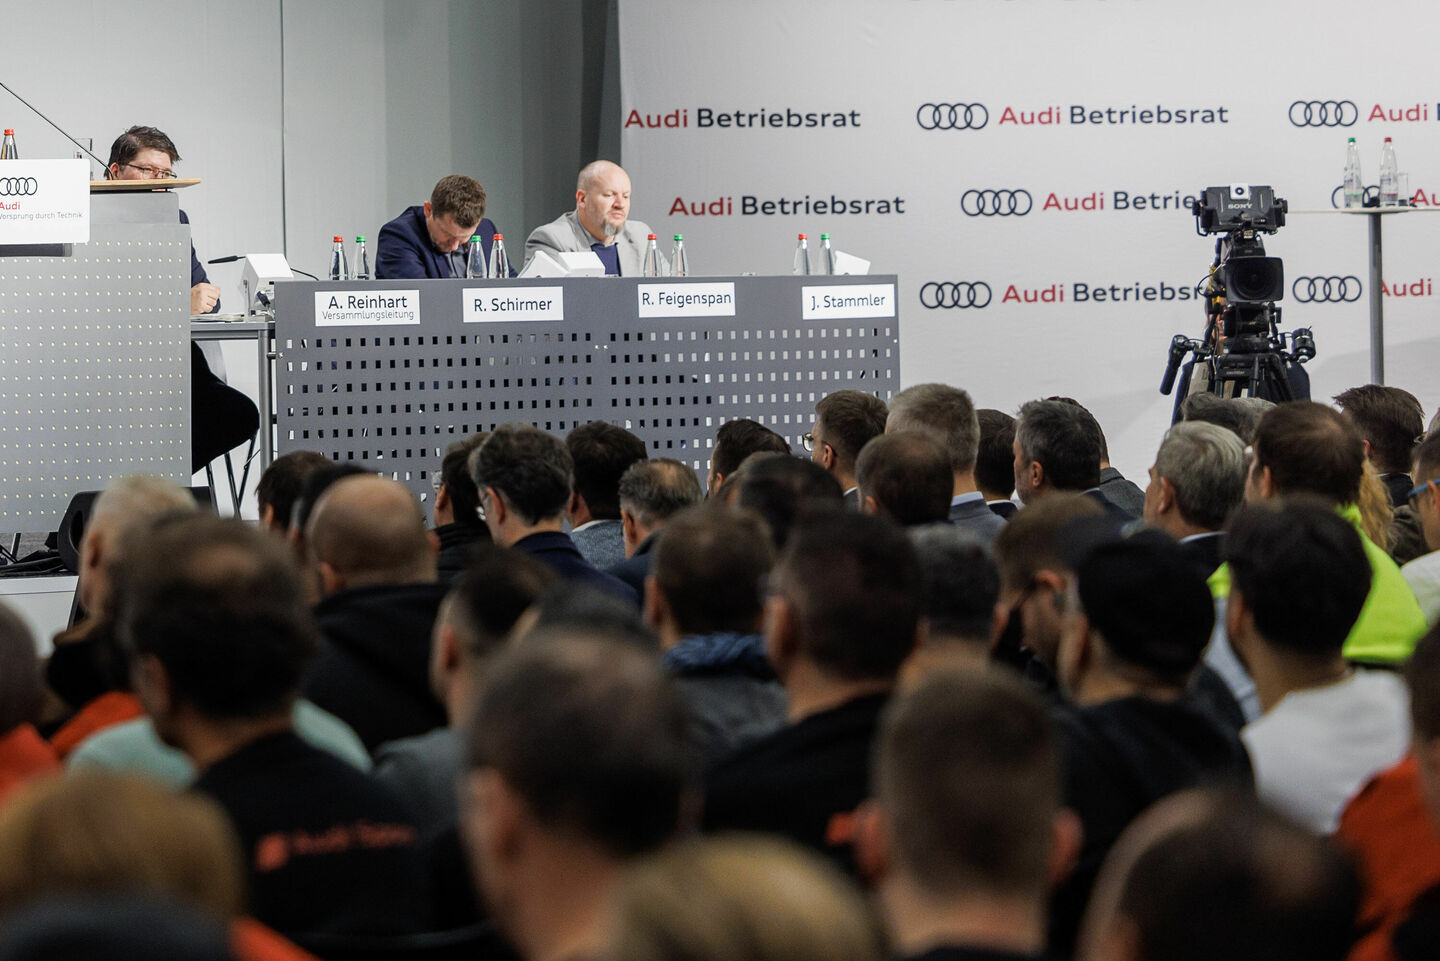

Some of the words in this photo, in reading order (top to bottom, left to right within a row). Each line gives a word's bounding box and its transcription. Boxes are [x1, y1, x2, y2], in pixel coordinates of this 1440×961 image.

[625, 109, 688, 128] Audi
[697, 107, 861, 128] Betriebsrat
[999, 106, 1061, 126] Audi
[1069, 104, 1229, 125] Betriebsrat
[1368, 103, 1428, 122] Audi
[669, 197, 732, 216] Audi
[741, 195, 905, 216] Betriebsrat
[1043, 192, 1104, 211] Audi
[1113, 190, 1196, 211] Betrie
[1227, 202, 1253, 210] SONY
[35, 211, 55, 219] durch
[57, 211, 82, 219] Technik
[328, 296, 343, 309] A.
[347, 294, 408, 309] Reinhart
[642, 292, 655, 307] R.
[658, 291, 732, 309] Feigenspan
[811, 295, 820, 310] J.
[823, 293, 886, 309] Stammler
[1001, 284, 1064, 304] Audi
[1073, 282, 1201, 303] Betriebsr
[474, 298, 487, 312] R.
[491, 297, 553, 312] Schirmer
[322, 309, 415, 321] Versammlungsleitung
